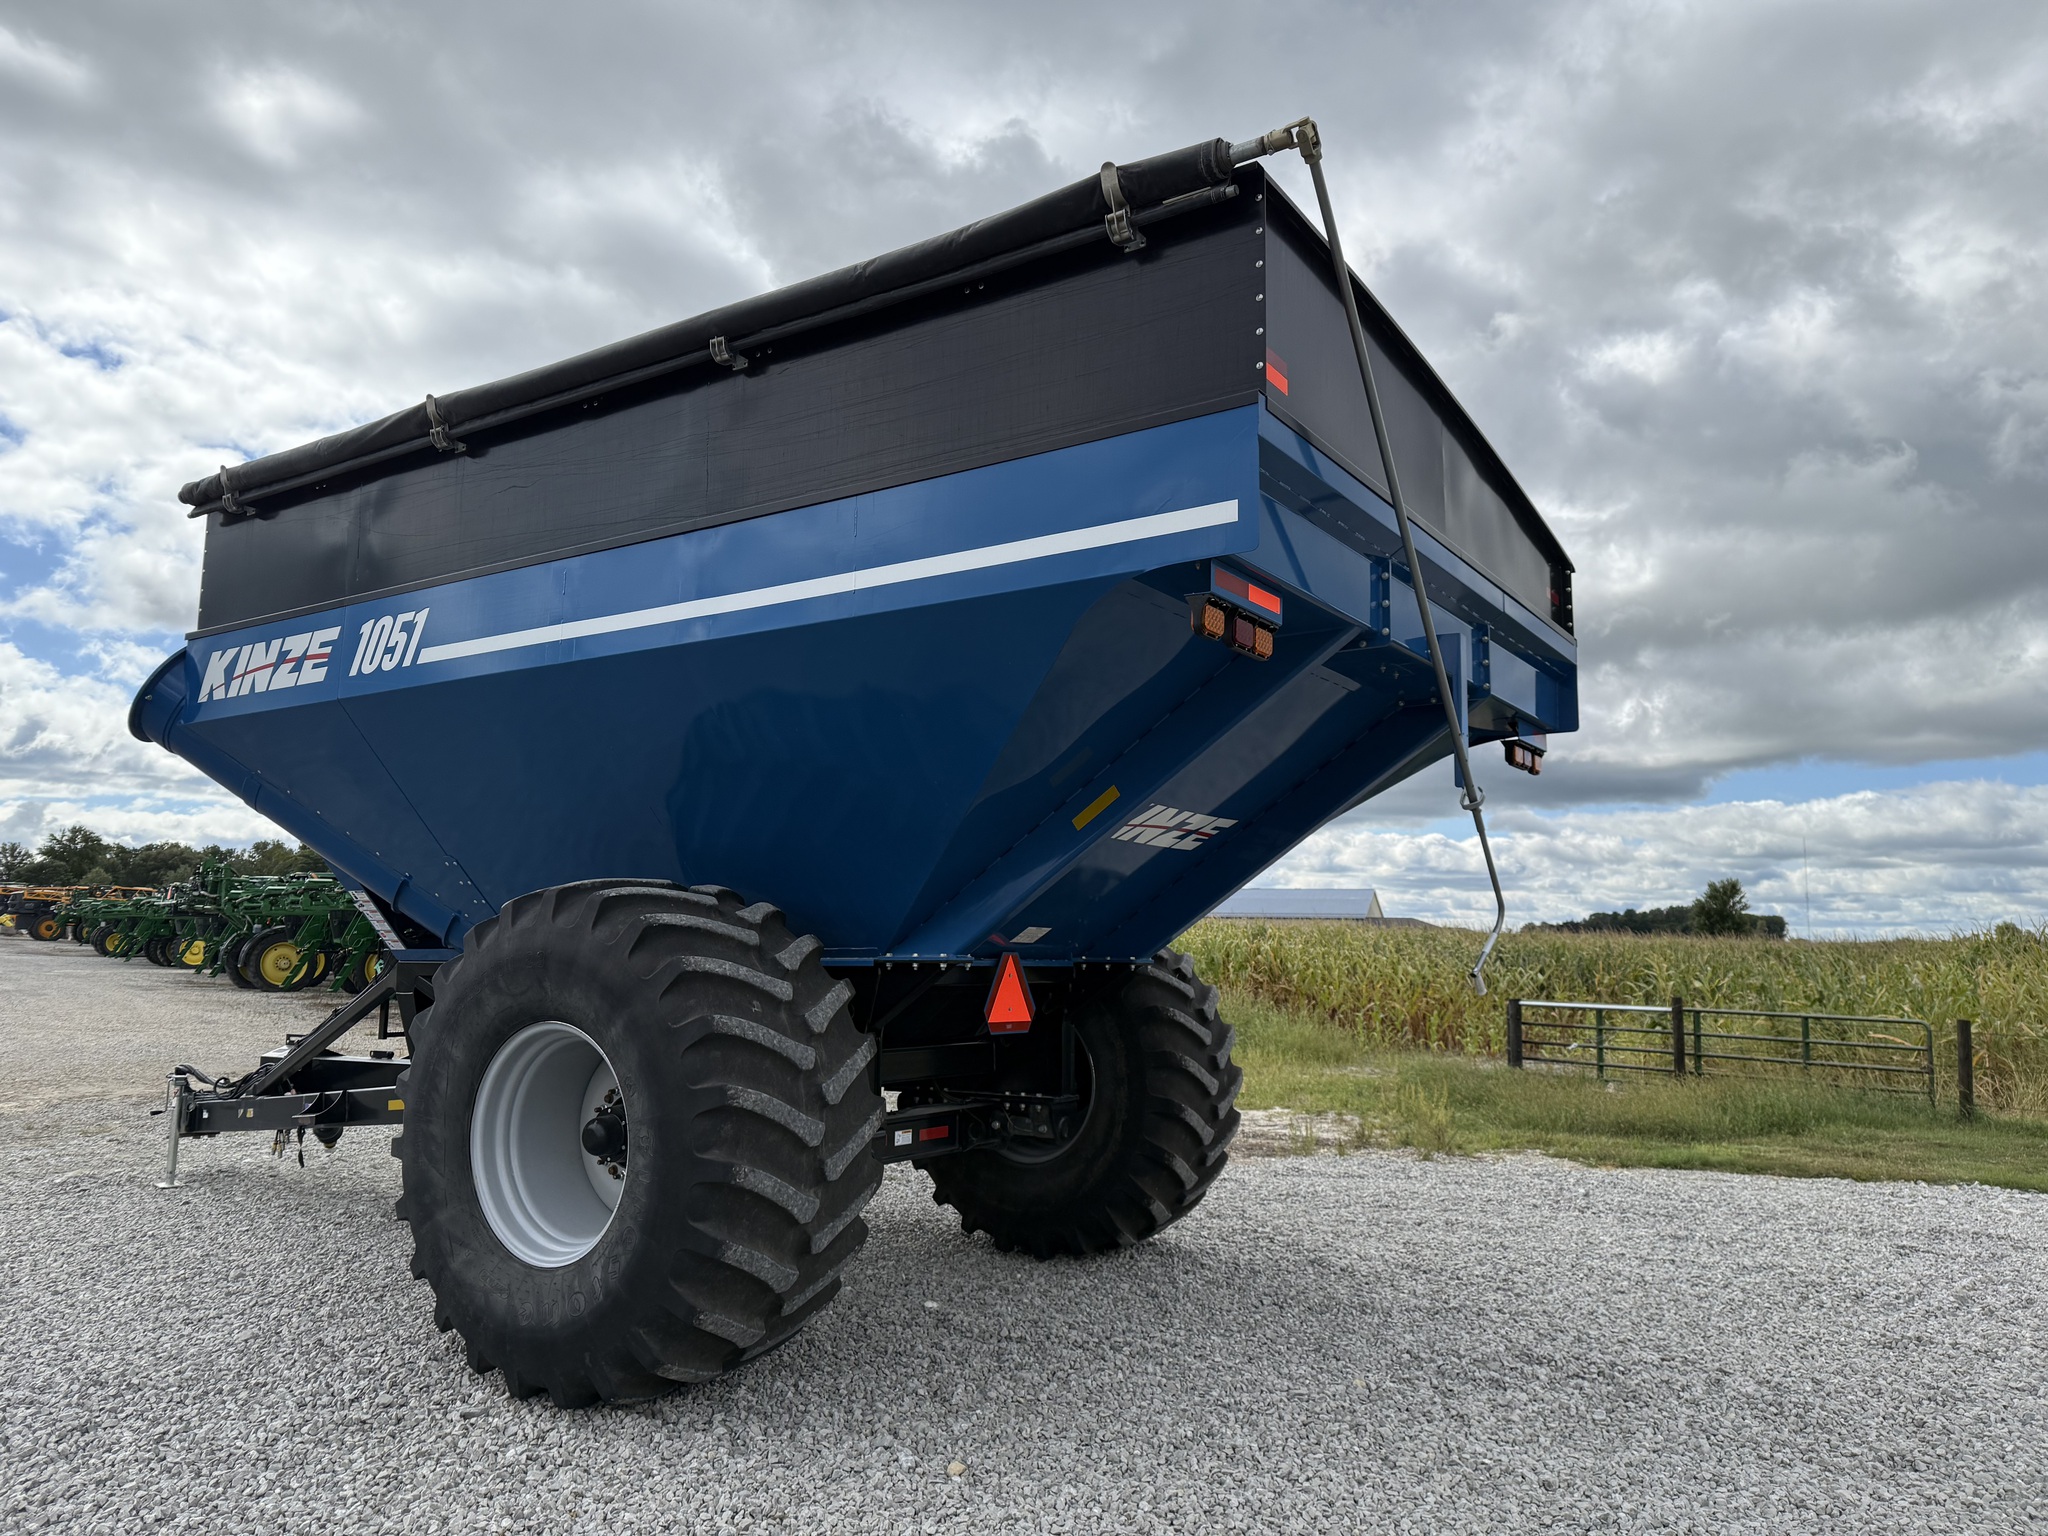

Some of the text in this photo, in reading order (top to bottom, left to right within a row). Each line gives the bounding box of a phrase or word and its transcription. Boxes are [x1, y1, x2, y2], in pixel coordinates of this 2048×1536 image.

[197, 607, 430, 704] KINZE 1051
[1110, 802, 1239, 851] INZE
